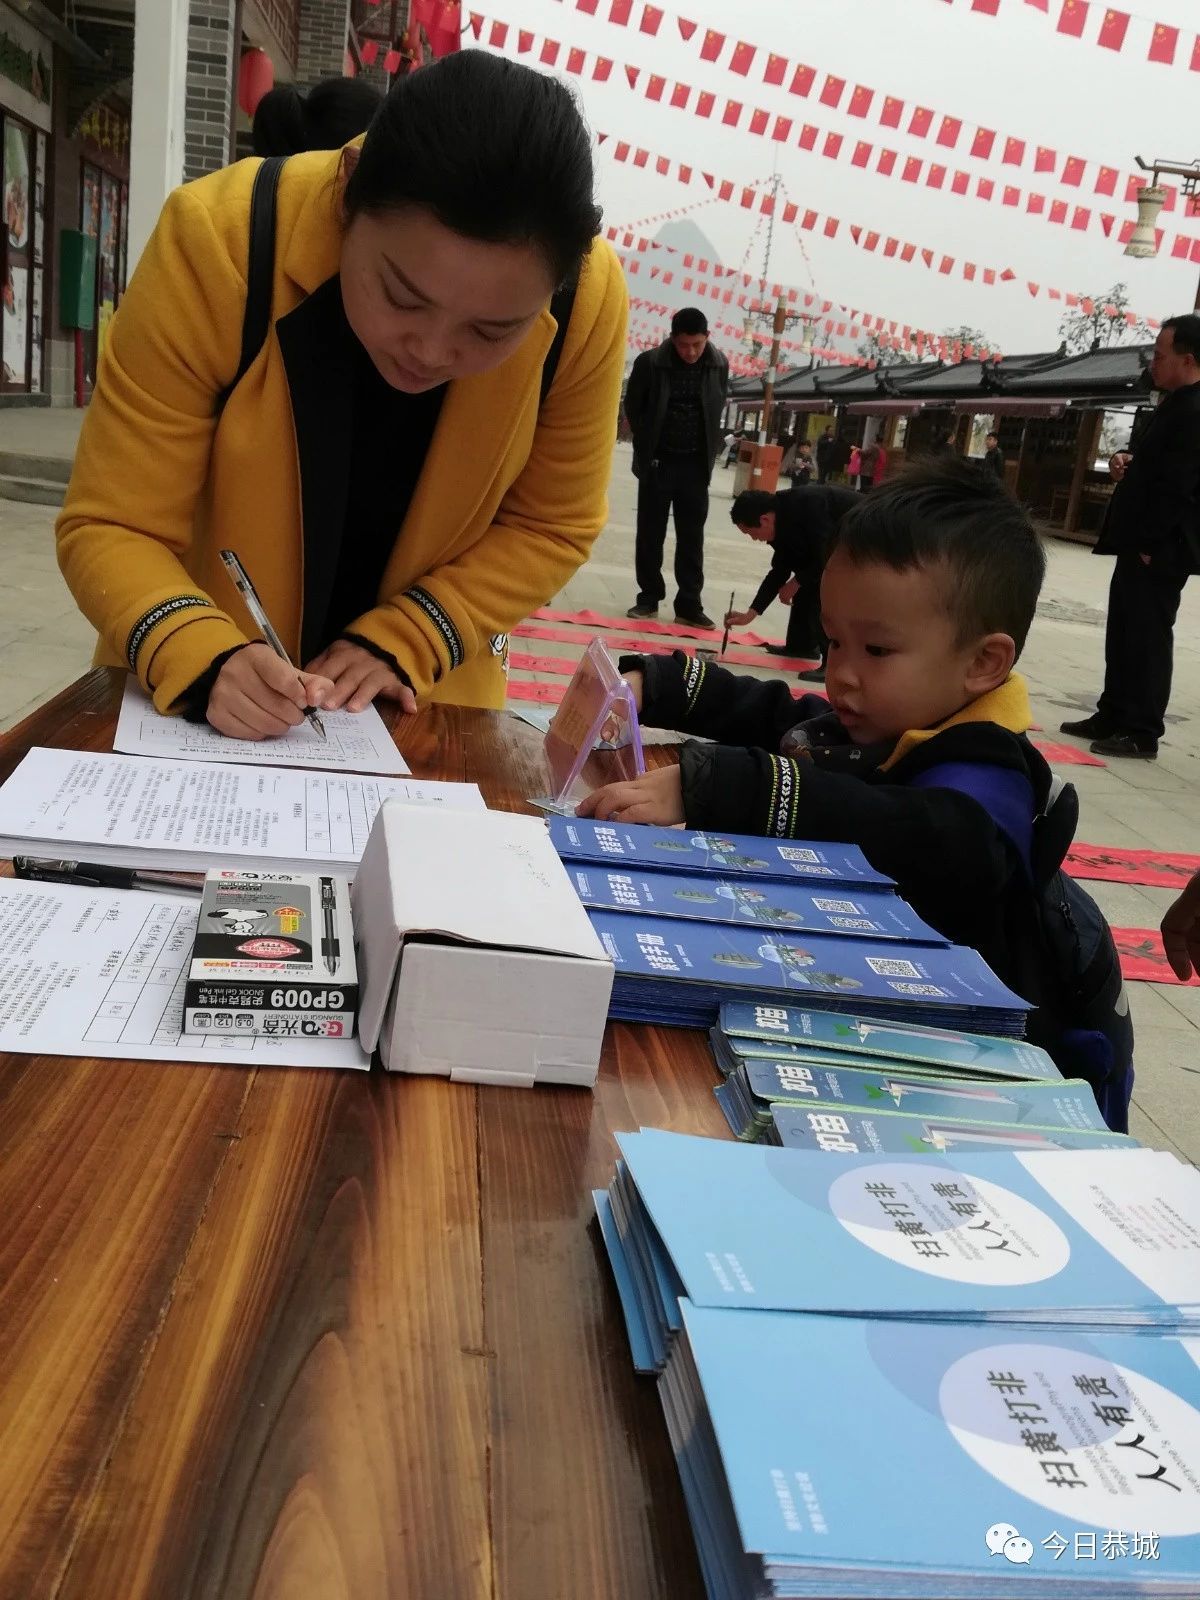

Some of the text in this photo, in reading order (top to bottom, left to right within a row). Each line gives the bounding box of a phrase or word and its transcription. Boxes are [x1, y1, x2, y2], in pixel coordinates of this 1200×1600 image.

[238, 988, 265, 996] SNOOK
[271, 989, 345, 1009] GP009
[217, 1018, 230, 1026] 12
[237, 1019, 252, 1027] 0.5
[262, 1019, 299, 1036] 光奇
[775, 1064, 819, 1097] 护苗
[865, 1182, 950, 1258] 扫黄打非
[930, 1182, 1022, 1257] 人人有责
[987, 1370, 1088, 1489] 扫黄打非
[1072, 1374, 1182, 1493] 人人有责
